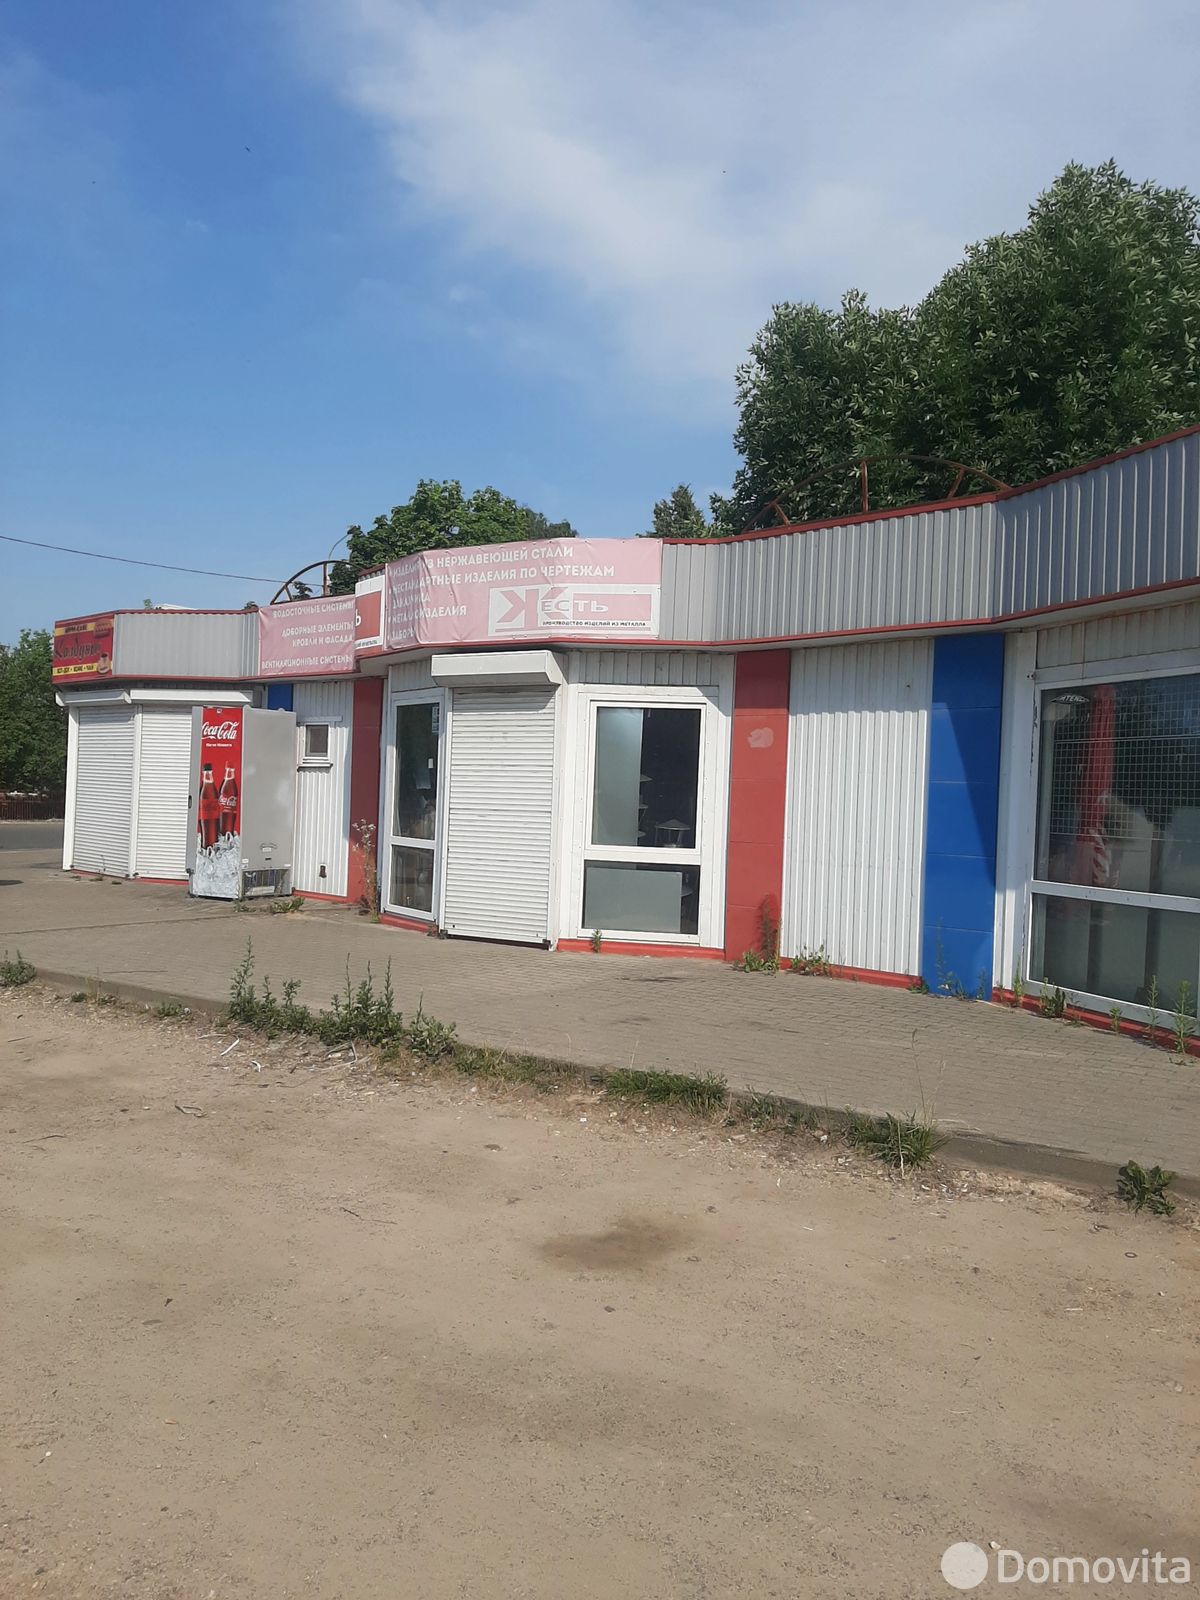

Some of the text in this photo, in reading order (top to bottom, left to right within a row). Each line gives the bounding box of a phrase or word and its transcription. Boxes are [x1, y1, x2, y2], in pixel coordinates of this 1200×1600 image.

[437, 549, 528, 568] НЕРЖАВЕЮЩЕЙ
[531, 546, 573, 560] СТАЛИ
[392, 565, 615, 595] НЕСТАНДАРТНЫЕ ИЗДЕЛИЯ ПО ЧЕРТЕЖАМ
[273, 601, 354, 619] ВОДОСТОЧНЫЕ СИСТЕМЫ
[282, 621, 354, 638] ДОБОРНЫЕ ЭЛЕМЕНТЫ
[292, 636, 318, 648] КРОВЛИ
[318, 636, 324, 645] И
[325, 634, 354, 645] ФАСАДА
[261, 654, 353, 669] ВЕНТИЛЯЦИОННЫЕ СИСТЕМЫ
